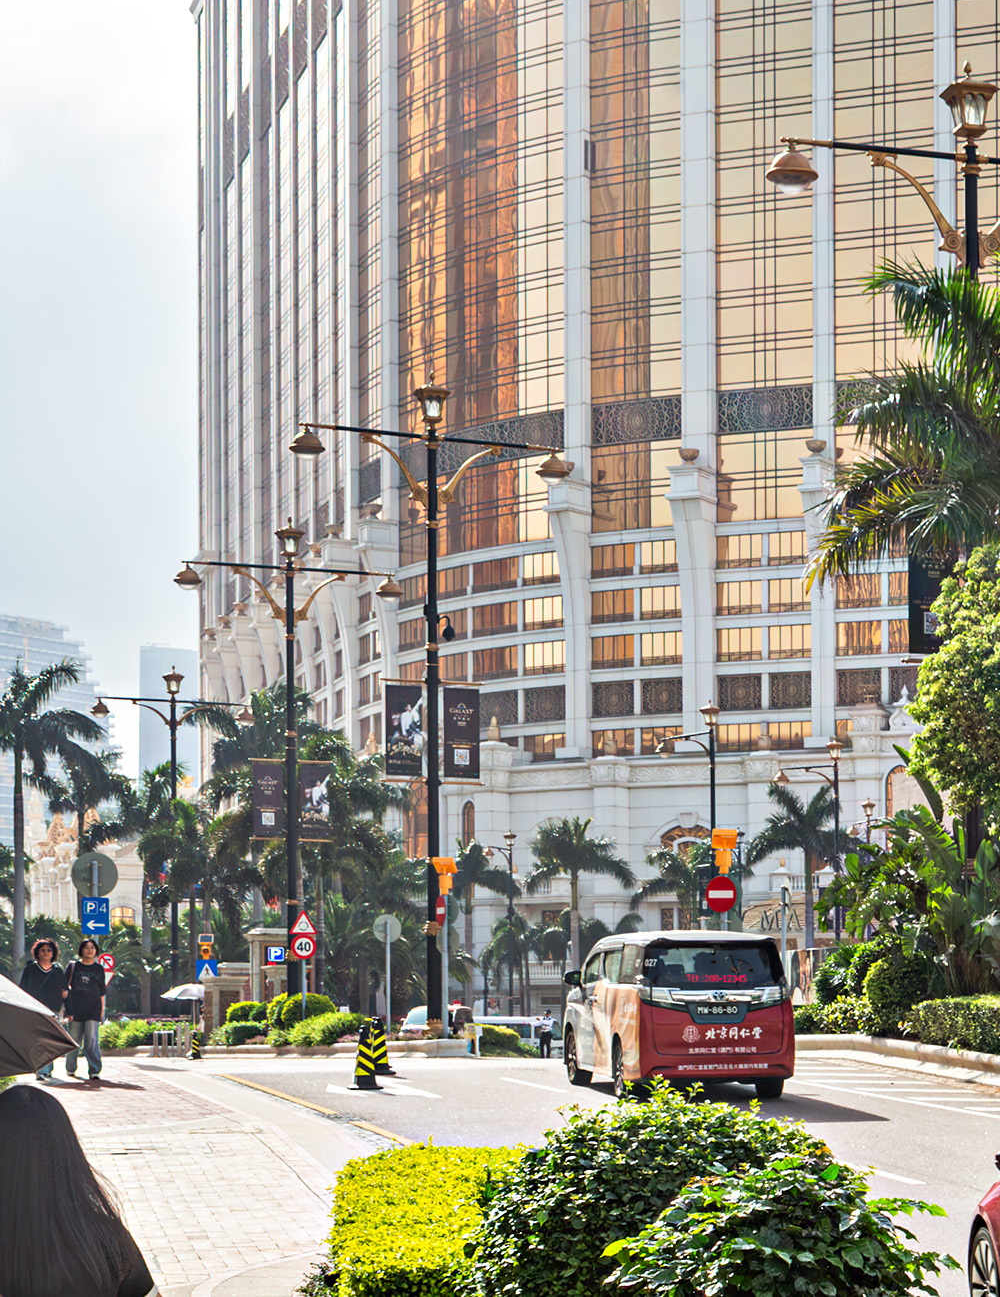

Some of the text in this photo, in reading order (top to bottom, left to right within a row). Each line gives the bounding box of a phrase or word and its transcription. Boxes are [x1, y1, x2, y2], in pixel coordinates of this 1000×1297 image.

[449, 707, 475, 715] GALAXY
[87, 902, 107, 914] P 4
[296, 942, 311, 952] 40
[270, 948, 282, 961] P
[644, 958, 657, 967] 027
[697, 1005, 738, 1014] MW-86-80
[705, 1026, 763, 1040] 北京同仁堂
